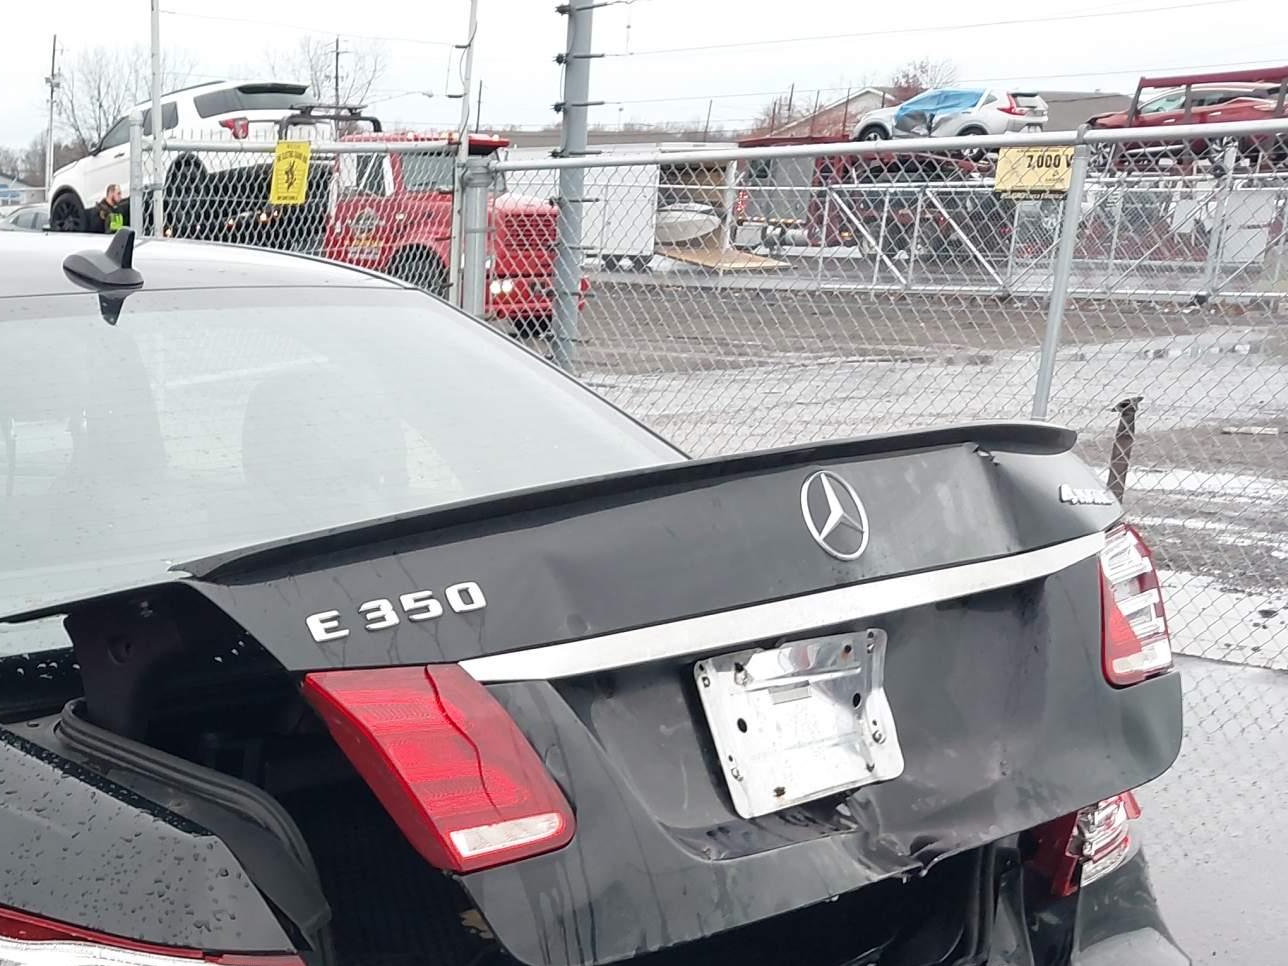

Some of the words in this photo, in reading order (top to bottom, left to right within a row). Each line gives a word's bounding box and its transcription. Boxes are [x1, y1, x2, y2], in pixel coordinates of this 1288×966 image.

[1026, 154, 1061, 170] 7,000
[305, 610, 350, 643] E
[358, 581, 487, 632] 350
